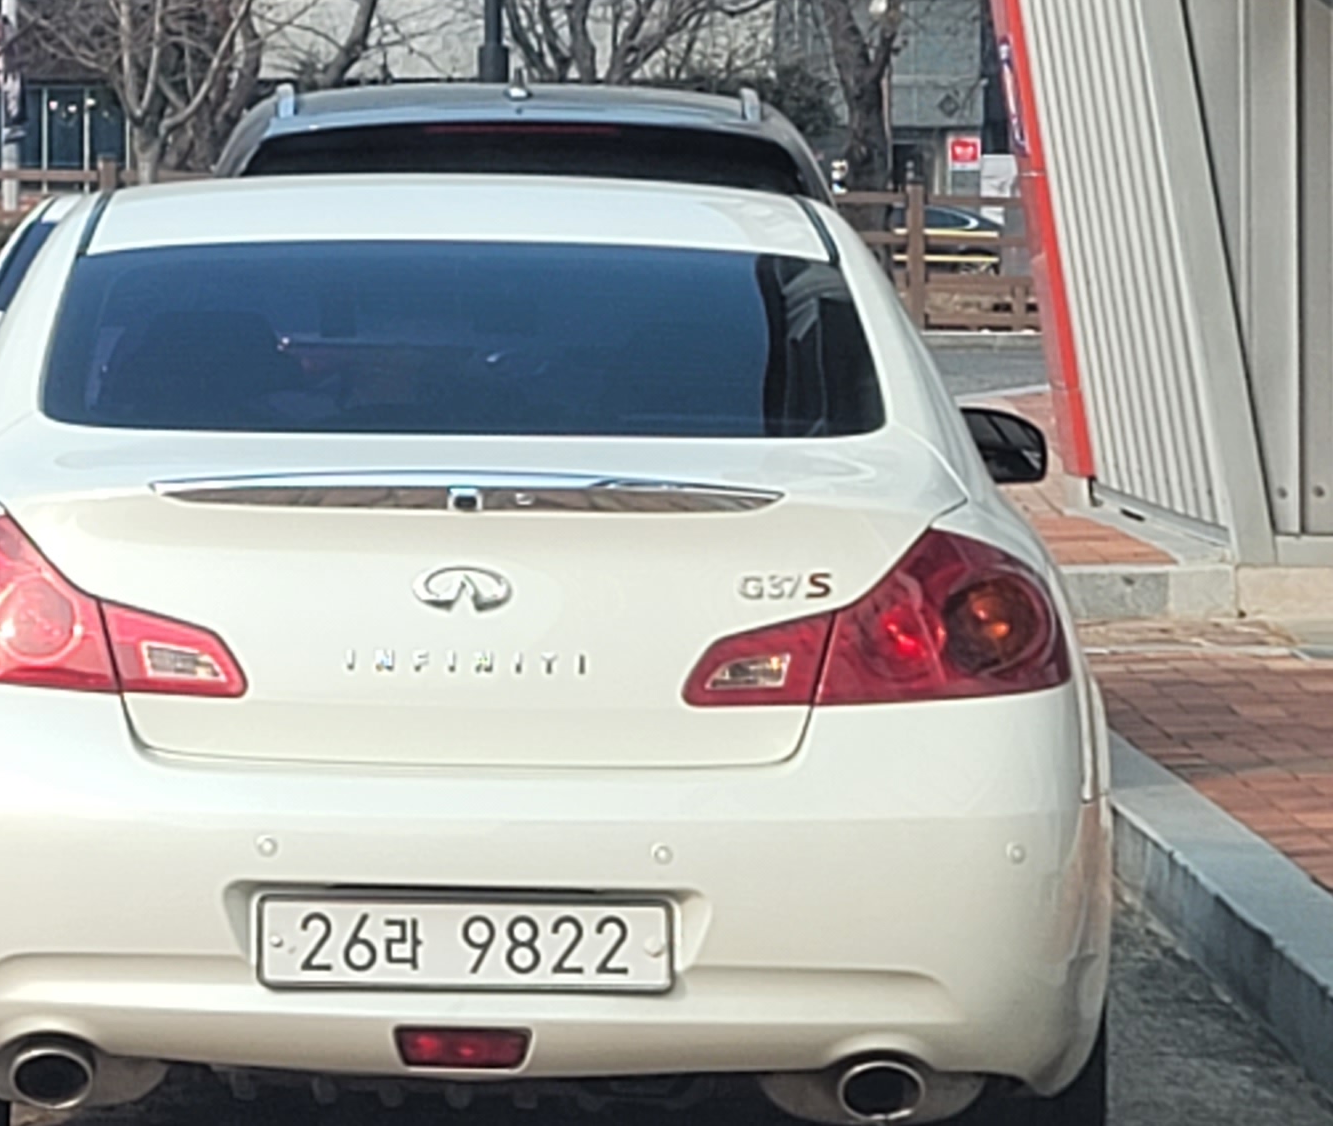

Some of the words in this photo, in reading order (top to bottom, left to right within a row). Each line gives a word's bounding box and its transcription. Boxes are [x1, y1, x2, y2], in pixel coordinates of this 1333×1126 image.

[345, 647, 586, 675] INFINITI
[299, 912, 424, 972] 26라
[461, 915, 630, 975] 9822
